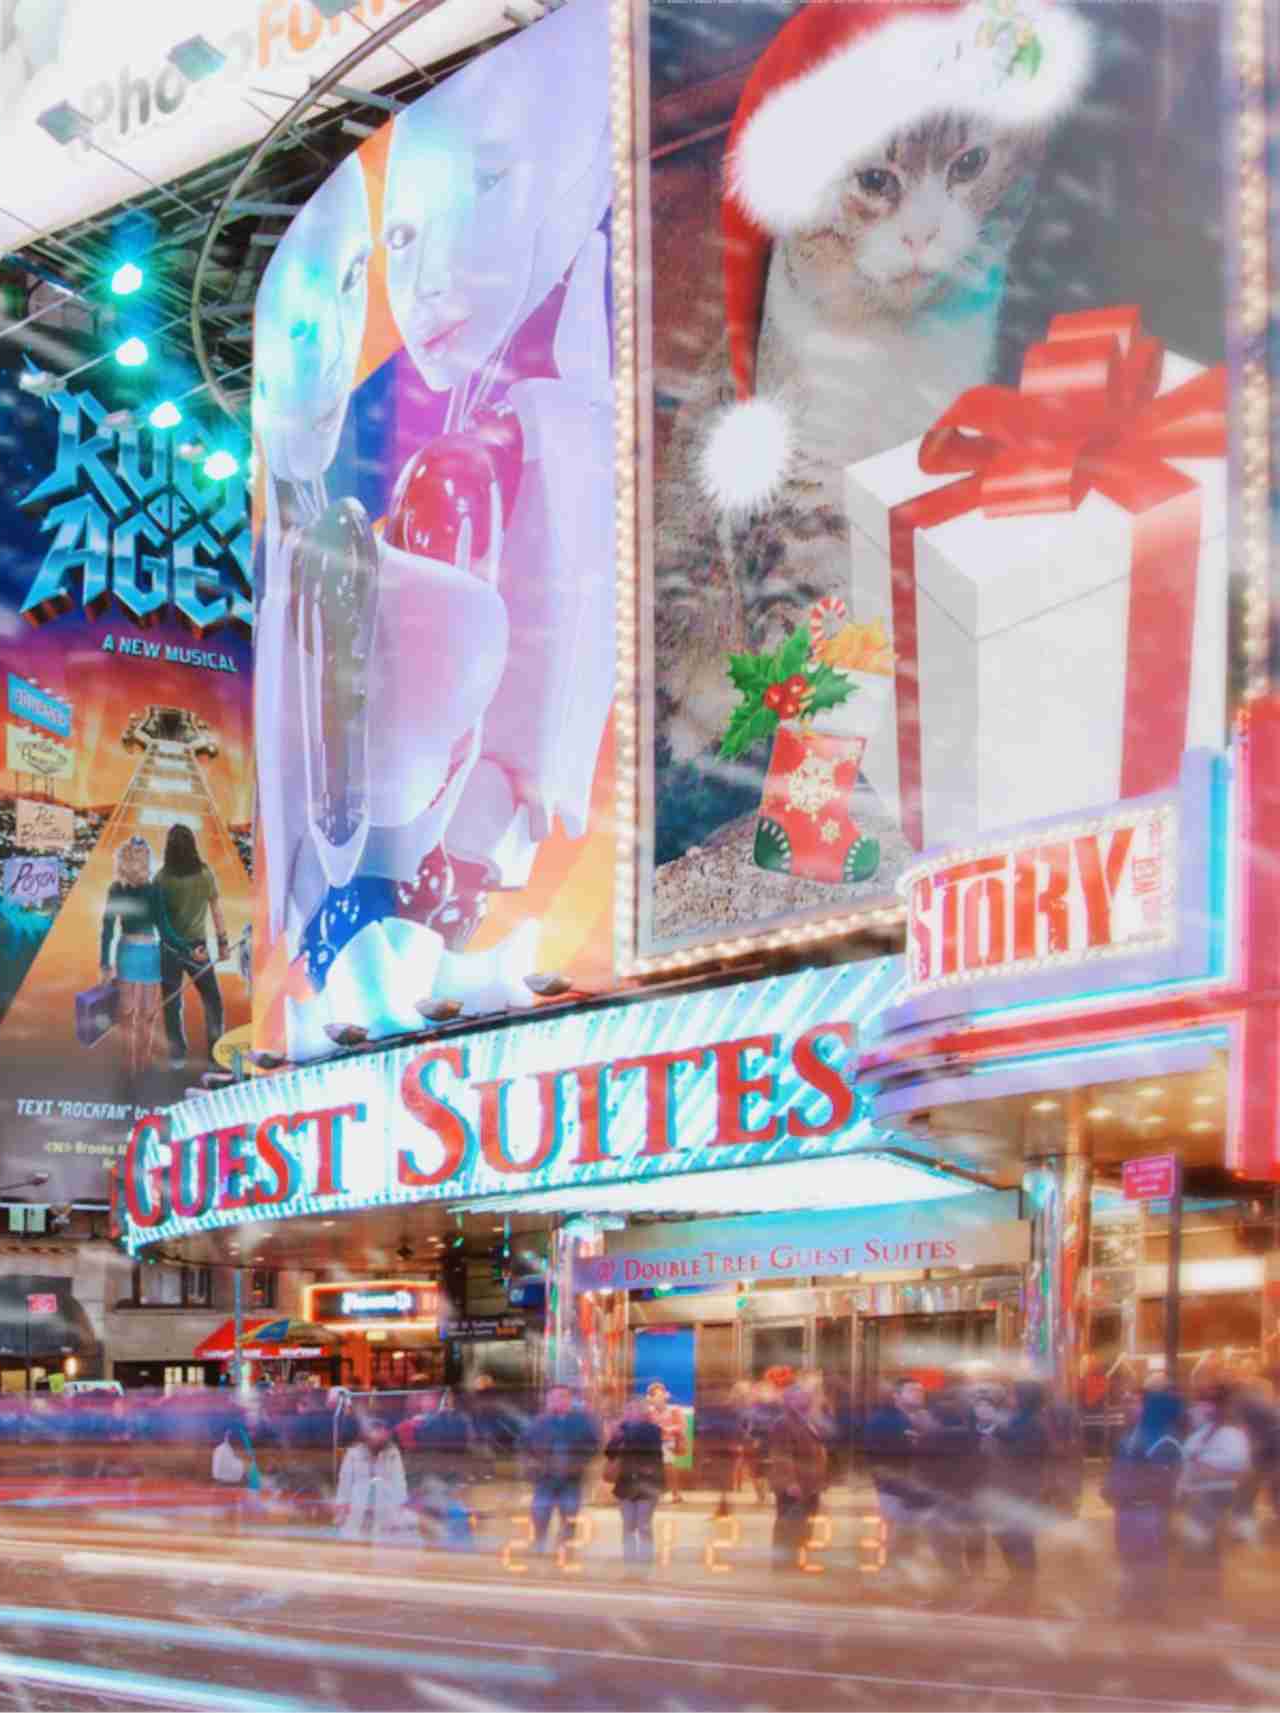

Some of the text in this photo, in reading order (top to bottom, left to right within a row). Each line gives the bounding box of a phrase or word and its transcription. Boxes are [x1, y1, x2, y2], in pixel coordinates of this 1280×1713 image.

[102, 634, 238, 673] A NEW MUSICAL
[16, 1098, 53, 1116] TEXT
[124, 1021, 861, 1229] GUEST SUITES
